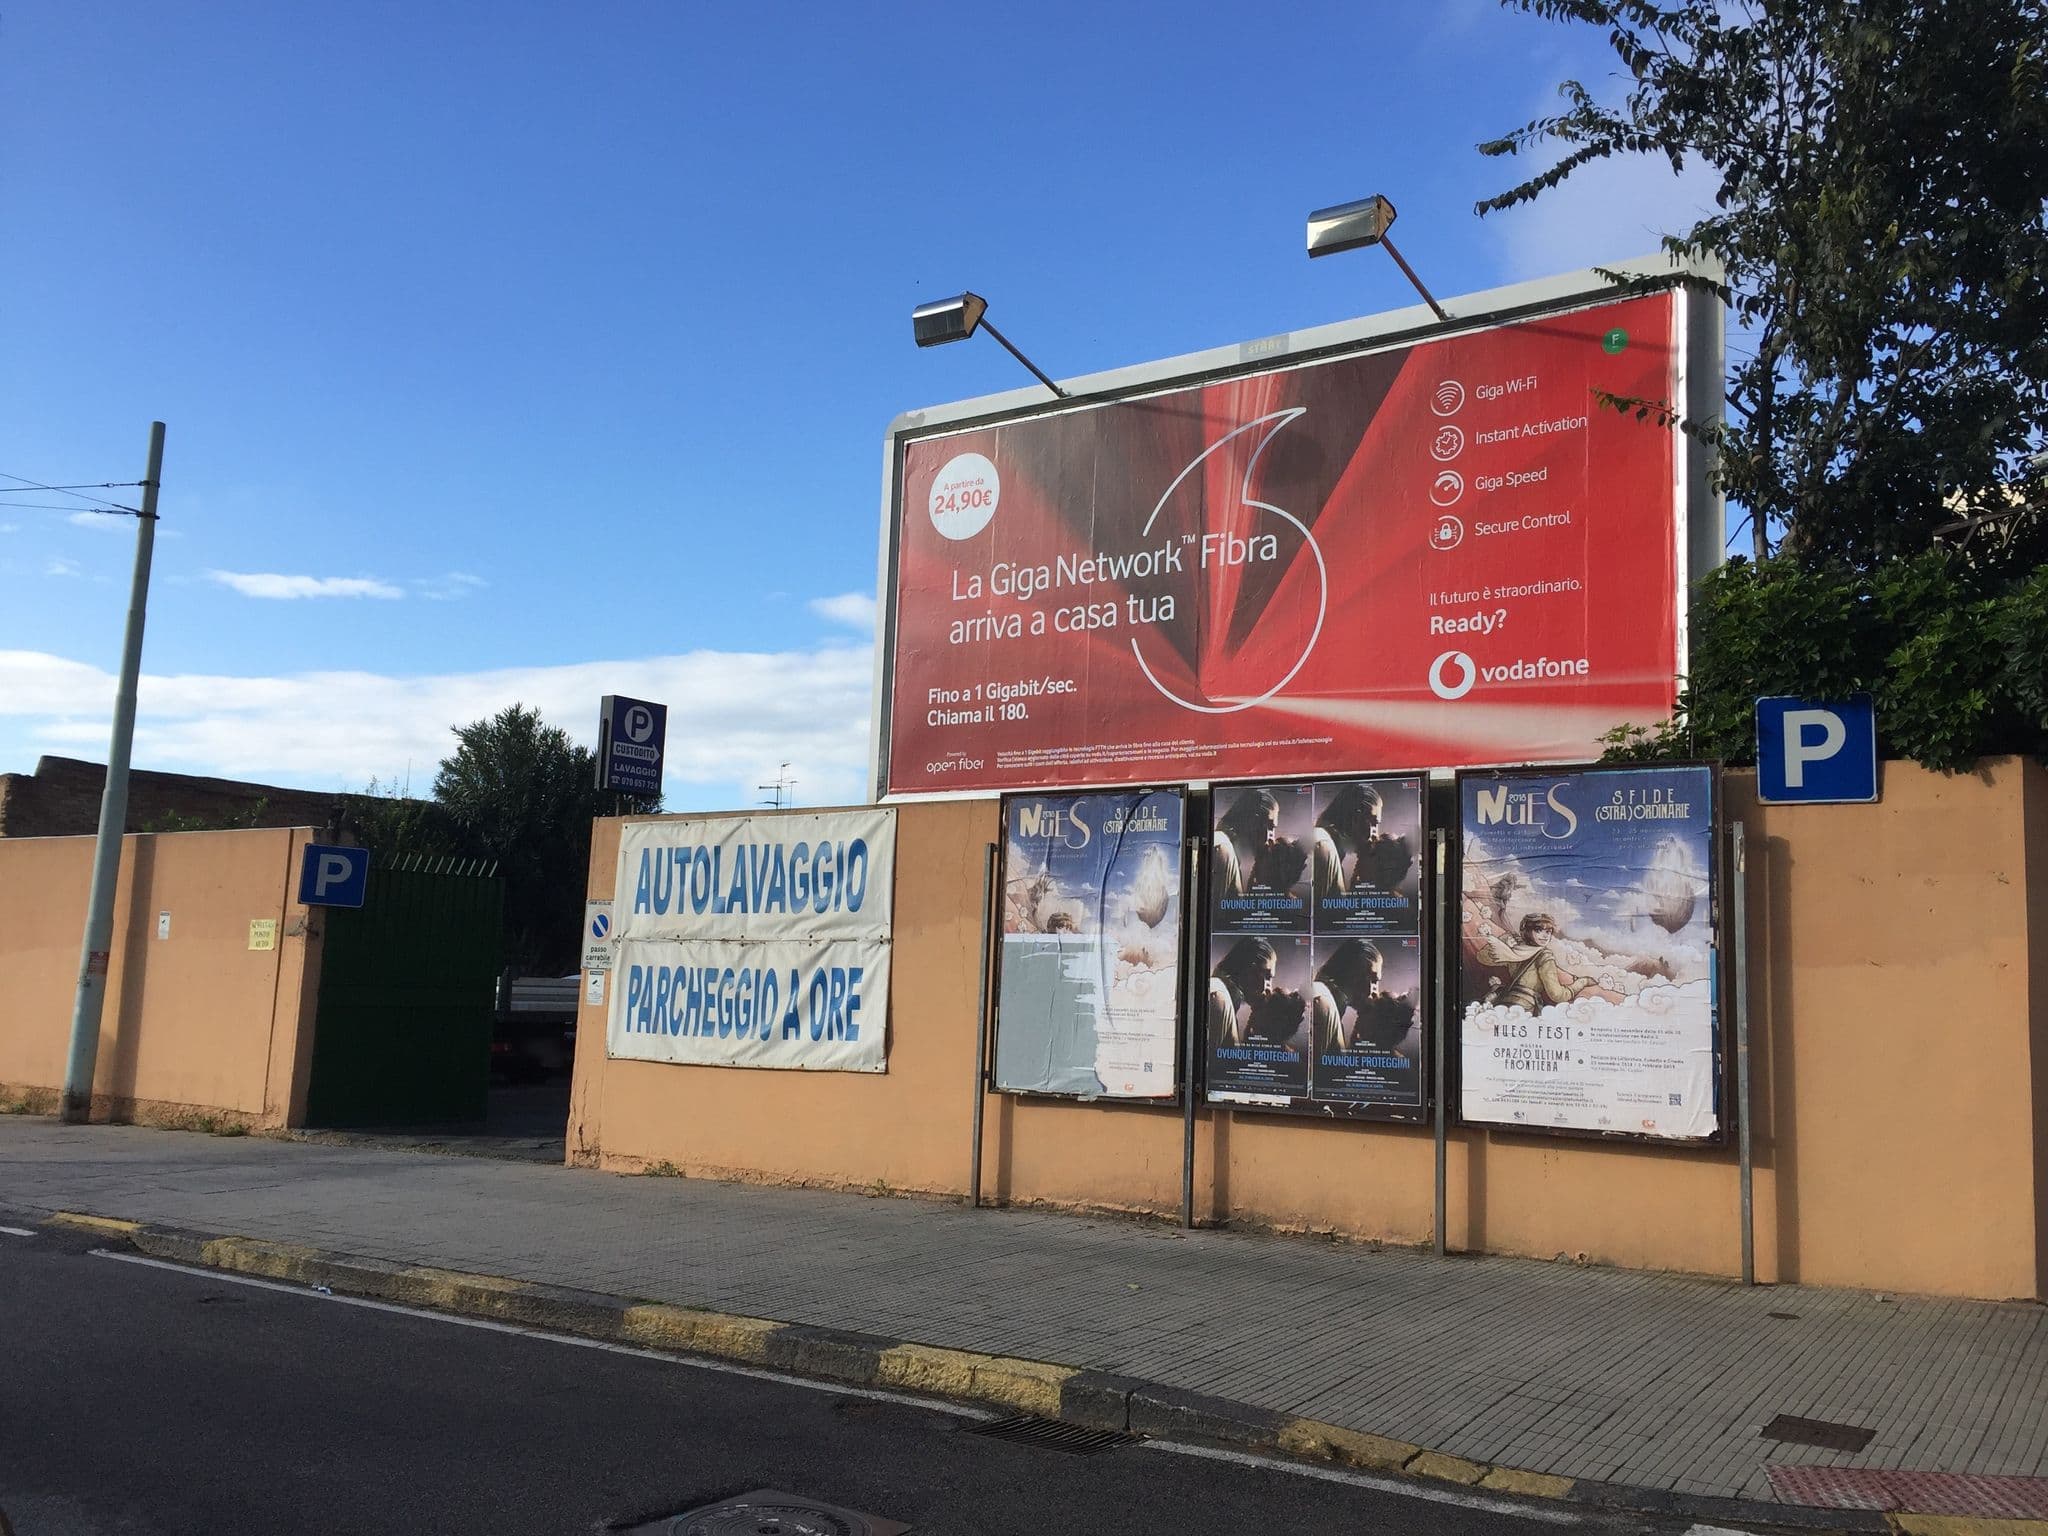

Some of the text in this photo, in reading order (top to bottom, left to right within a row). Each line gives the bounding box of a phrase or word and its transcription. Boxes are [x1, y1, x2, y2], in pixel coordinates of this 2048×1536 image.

[1475, 375, 1537, 400] Giga Wi-Fi
[1475, 416, 1588, 445] Instant Activation
[943, 477, 984, 493] A partire da
[1475, 467, 1548, 492] Giga Speed
[934, 491, 993, 516] 24,90€
[1475, 511, 1571, 536] Secure Control
[952, 569, 982, 601] La
[991, 562, 1049, 600] Giga
[1202, 533, 1278, 569] Fibra
[1430, 577, 1583, 606] Il futuro è straordinario.
[950, 594, 1175, 644] arriva a casa tua
[1430, 608, 1507, 635] Ready?
[1481, 656, 1589, 682] vodafone
[928, 676, 1077, 706] Fino a 1 Gigabit/sec.
[630, 709, 650, 738] P
[927, 703, 1029, 727] Chiama il 180.
[615, 743, 656, 760] CUSTODITO
[1783, 709, 1846, 788] P
[614, 762, 658, 777] LAVAGGIO
[926, 761, 957, 775] open
[959, 757, 985, 771] fiber
[315, 853, 353, 897] P
[633, 837, 869, 915] AUTOLAVAGGIO
[1220, 899, 1257, 911] OVUNQUE
[1322, 897, 1409, 911] OVUNQUE PROTEGGIMI
[585, 953, 611, 962] carrabile
[590, 946, 608, 954] passo
[626, 964, 865, 1042] PARCHEGGIO A ORE
[1493, 1024, 1571, 1040] NUES FEST
[1216, 1048, 1300, 1064] OVUNQUE PROTEGGIMI
[1321, 1055, 1411, 1070] OVUNQUE PROTEGGIMI
[1493, 1047, 1571, 1062] SPAZIO ULTIMA
[1504, 1058, 1559, 1072] FRONTIERA
